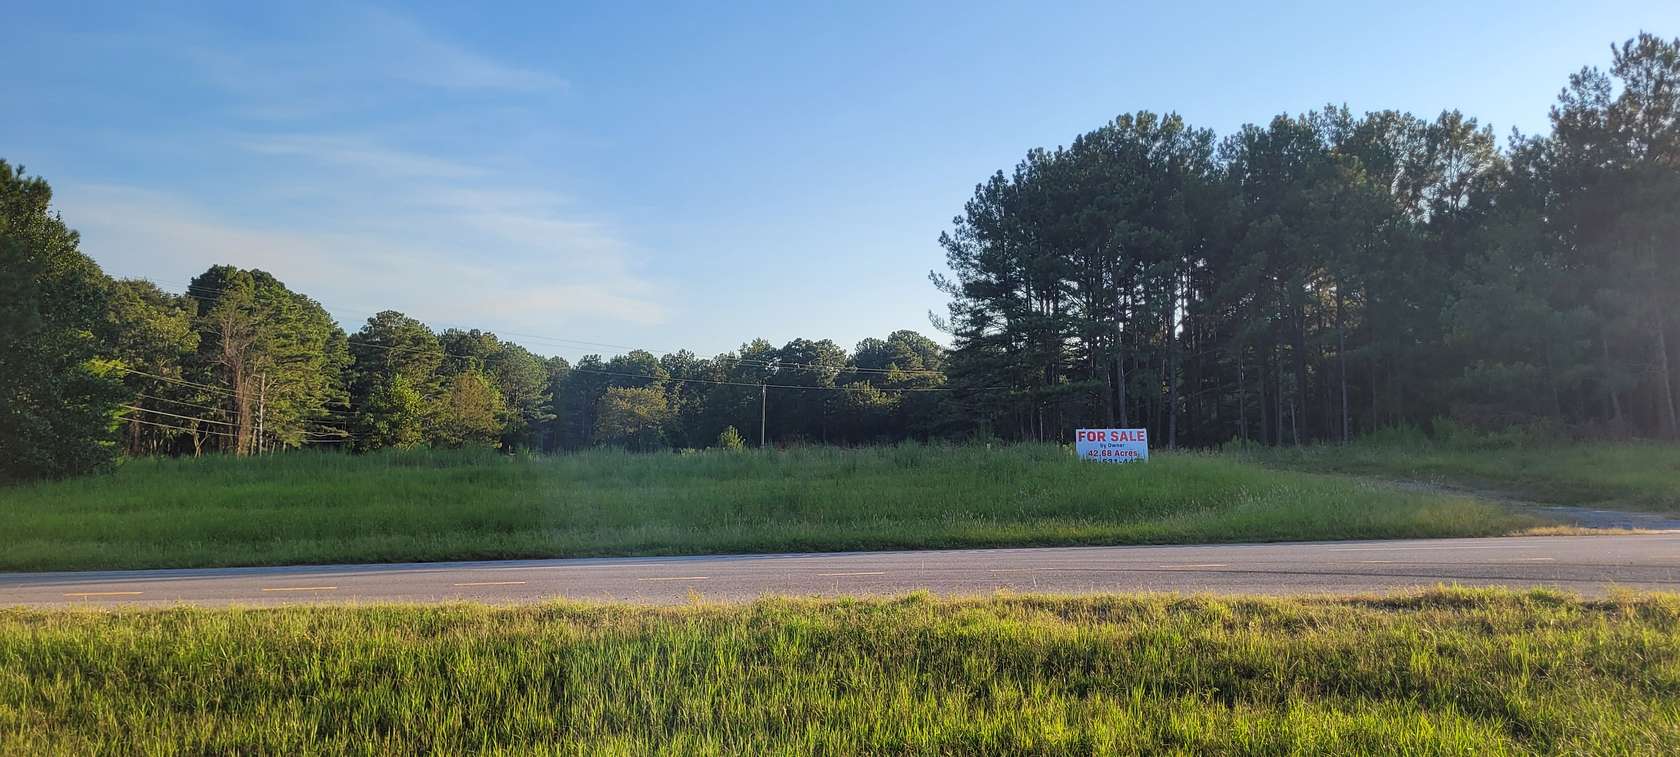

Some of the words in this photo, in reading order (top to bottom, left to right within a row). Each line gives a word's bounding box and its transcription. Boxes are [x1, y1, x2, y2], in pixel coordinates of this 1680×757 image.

[1078, 431, 1106, 442] FOR
[1110, 431, 1145, 442] SALE
[1088, 449, 1112, 457] 42.68
[1114, 449, 1138, 457] Acres
